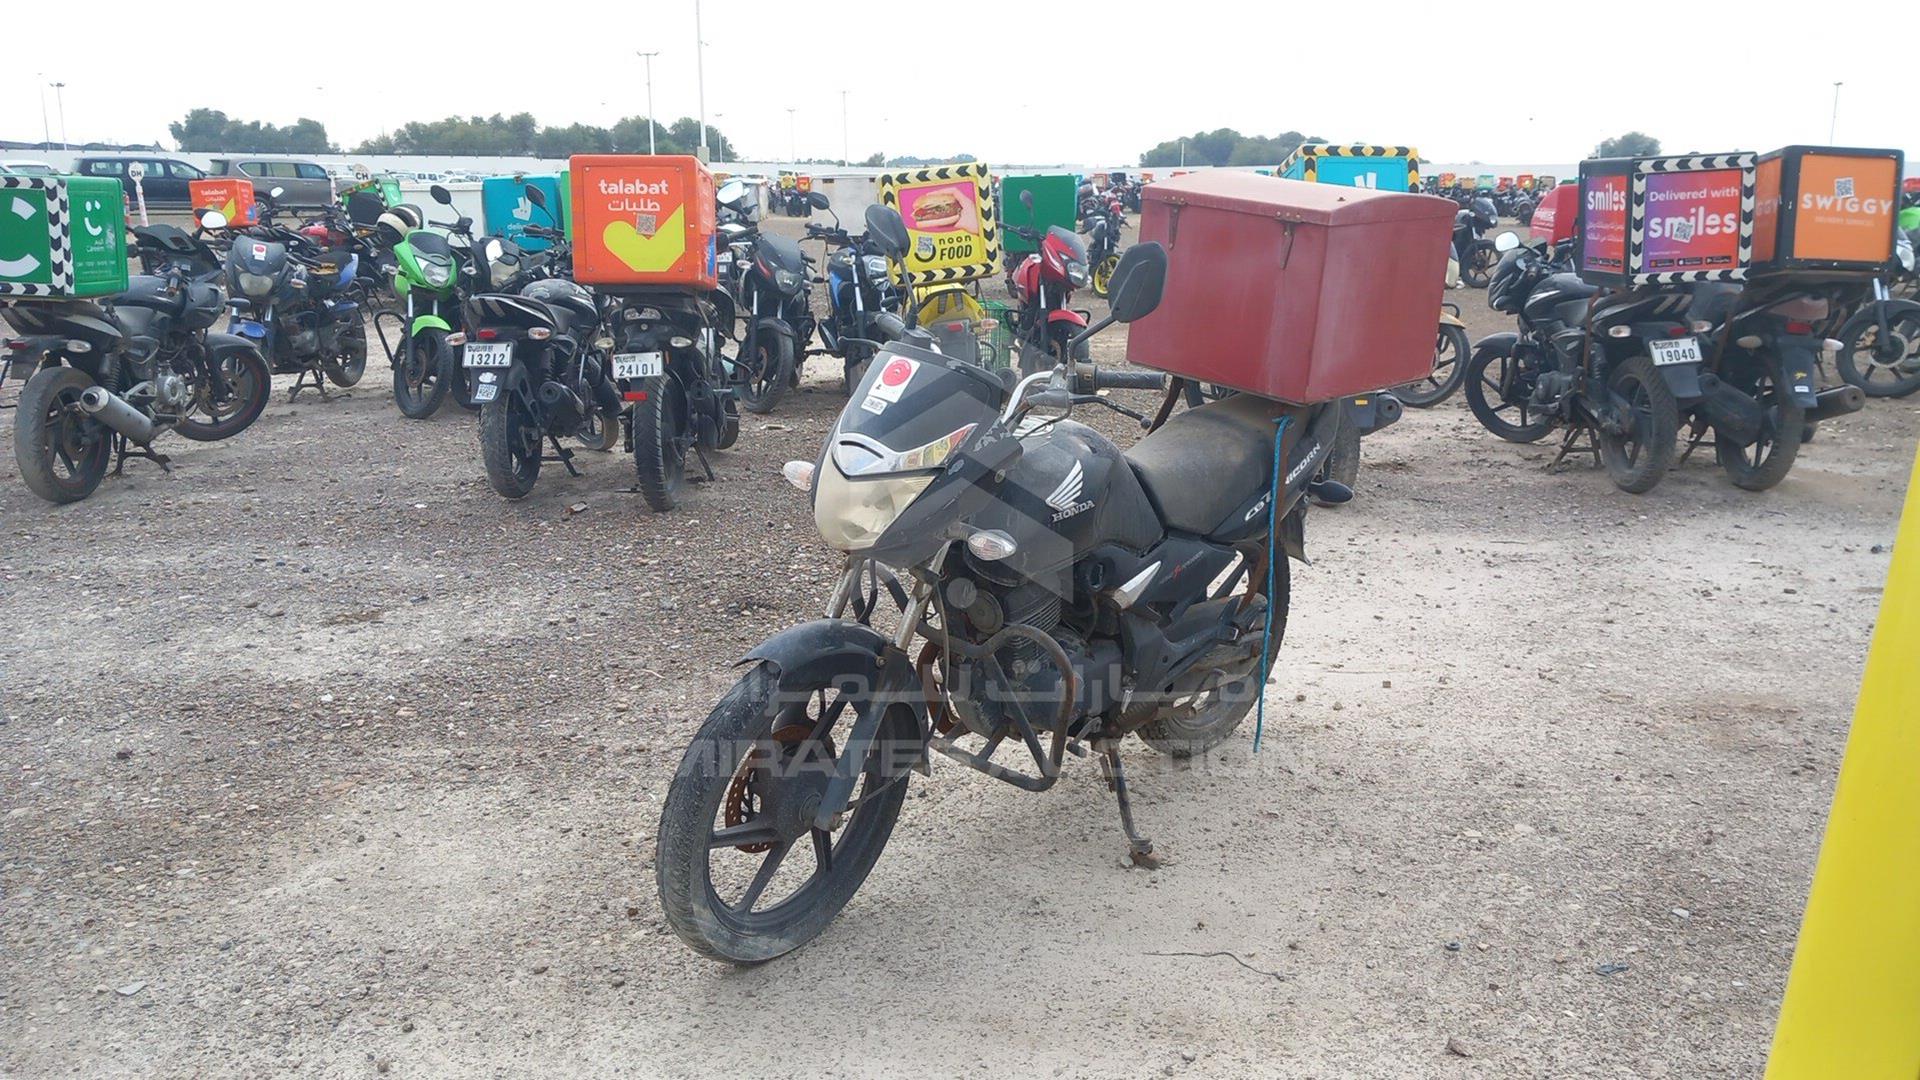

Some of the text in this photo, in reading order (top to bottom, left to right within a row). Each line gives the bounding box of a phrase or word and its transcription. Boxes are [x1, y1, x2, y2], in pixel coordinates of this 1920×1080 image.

[355, 172, 369, 180] CH
[598, 178, 669, 195] talabat
[1649, 186, 1739, 202] Delivered with
[1587, 182, 1627, 211] smiles
[1801, 193, 1893, 216] SWIGGY
[607, 198, 661, 215] طلبات
[1648, 206, 1738, 238] smiles
[939, 235, 972, 245] noon
[940, 244, 972, 261] FOOD
[470, 353, 505, 365] 13212
[1660, 348, 1696, 362] 19040
[619, 363, 654, 377] 24101
[1052, 500, 1096, 523] HONDA
